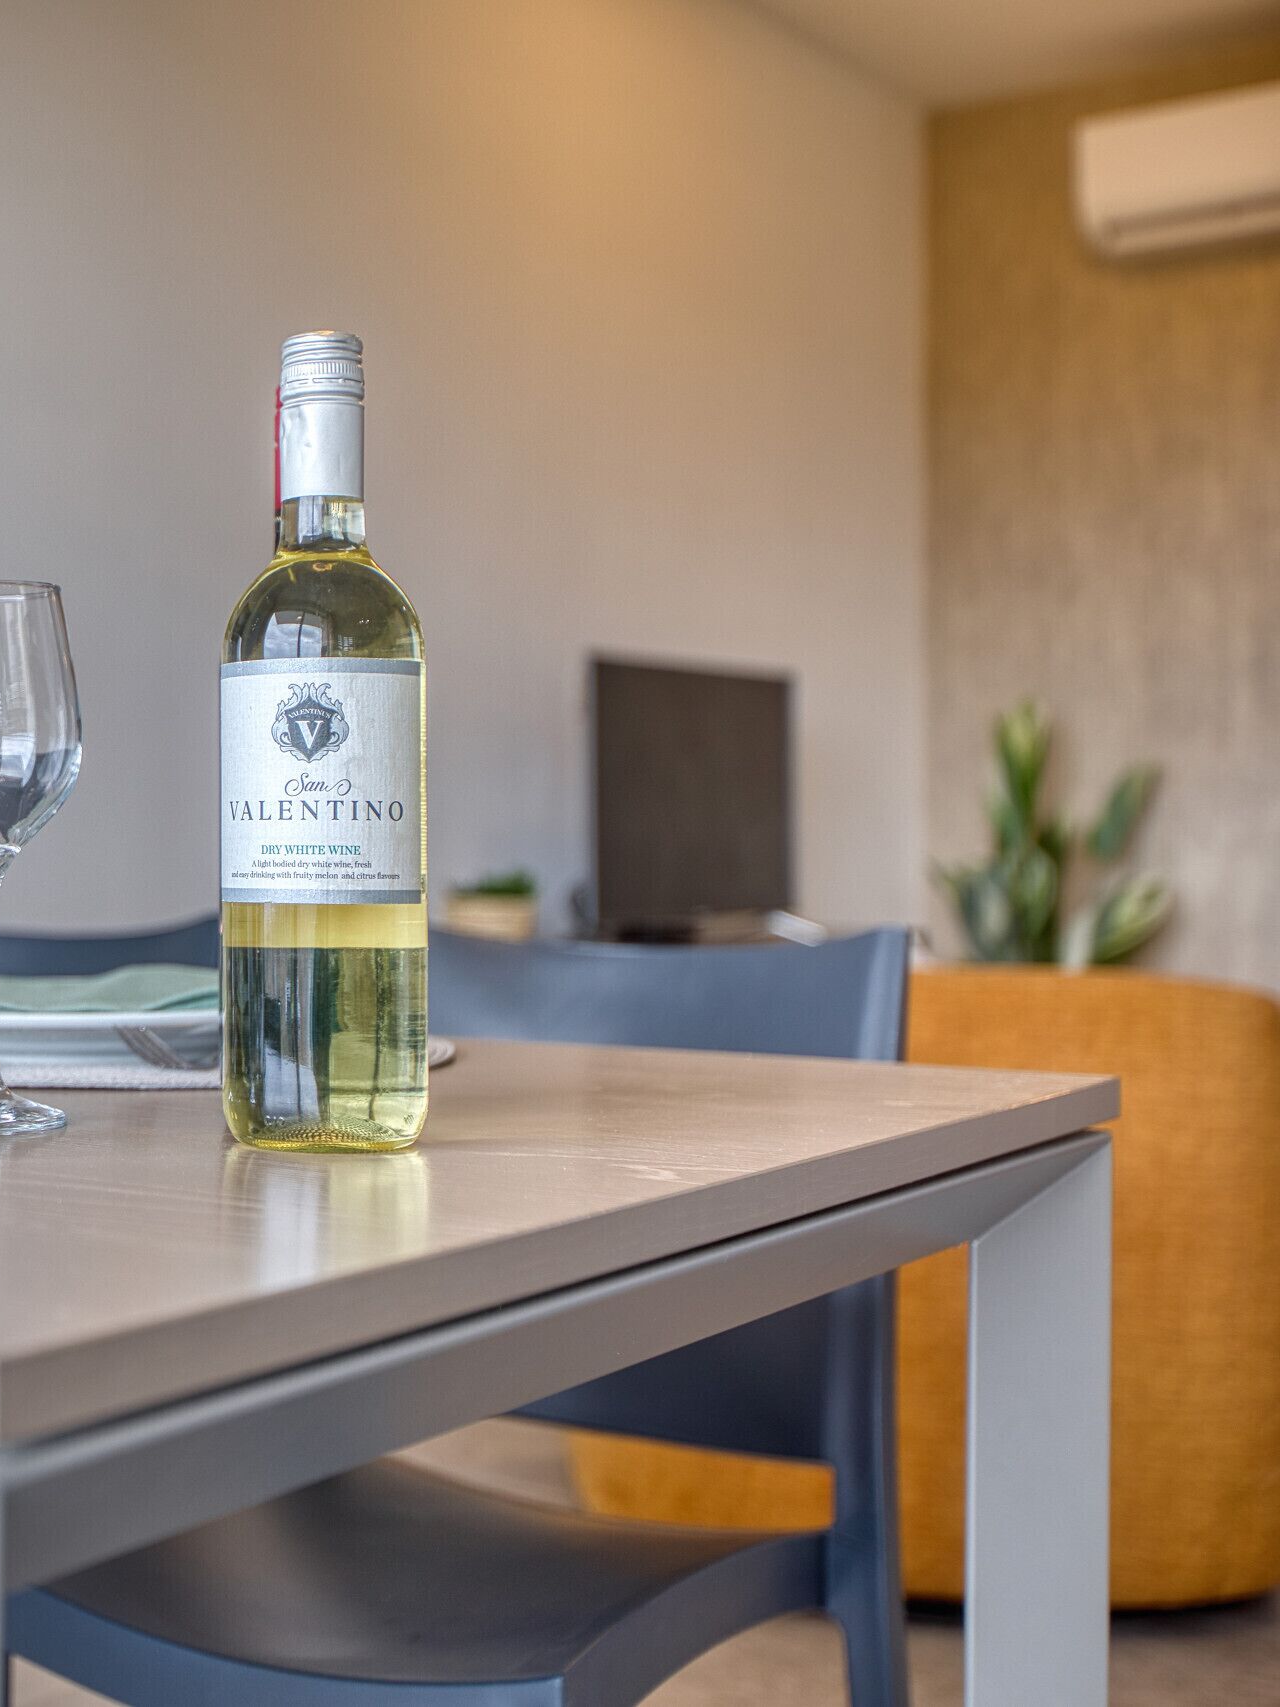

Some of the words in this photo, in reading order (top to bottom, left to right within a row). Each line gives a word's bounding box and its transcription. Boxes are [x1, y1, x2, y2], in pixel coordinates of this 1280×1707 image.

[288, 708, 332, 719] VALENTINUS
[295, 720, 324, 749] V
[285, 772, 351, 797] San
[229, 800, 404, 822] VALENTINO
[261, 844, 282, 855] DRY
[285, 844, 326, 855] WHITE
[328, 845, 361, 855] WINE
[251, 860, 257, 868] A
[257, 860, 272, 869] light
[272, 860, 296, 868] bodied
[297, 860, 310, 869] dry
[311, 860, 332, 868] white
[333, 861, 353, 869] wine,
[354, 860, 372, 868] fresh
[250, 871, 276, 880] drinking
[293, 872, 313, 880] fruity
[341, 872, 355, 880] and
[356, 872, 376, 880] citrus
[377, 872, 400, 880] flavours
